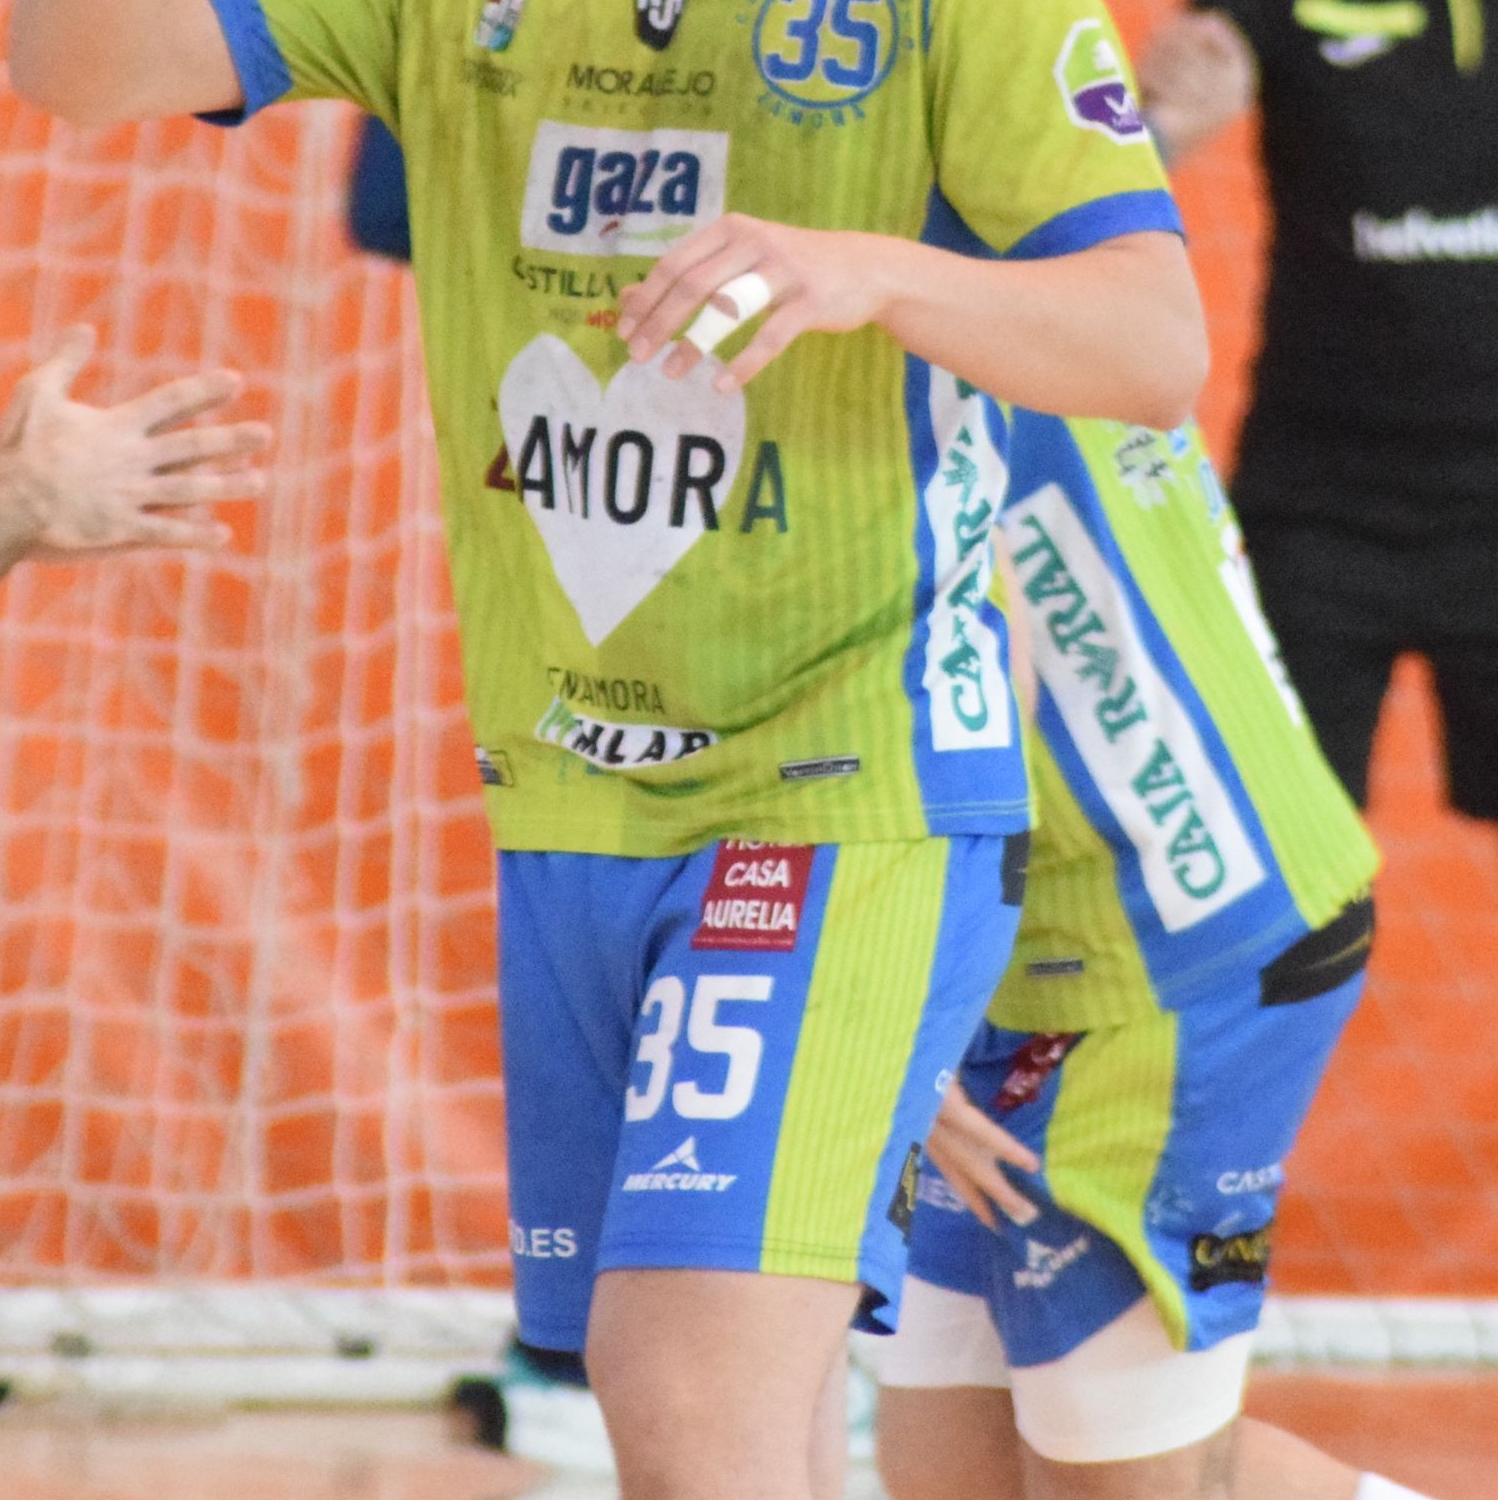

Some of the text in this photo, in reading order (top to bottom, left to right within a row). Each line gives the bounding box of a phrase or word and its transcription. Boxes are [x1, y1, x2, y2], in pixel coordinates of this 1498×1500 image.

[547, 147, 701, 236] gaza
[723, 858, 792, 888] CASA
[703, 899, 796, 931] AURELIA
[625, 975, 775, 1123] 35
[622, 1174, 738, 1192] MERCURY
